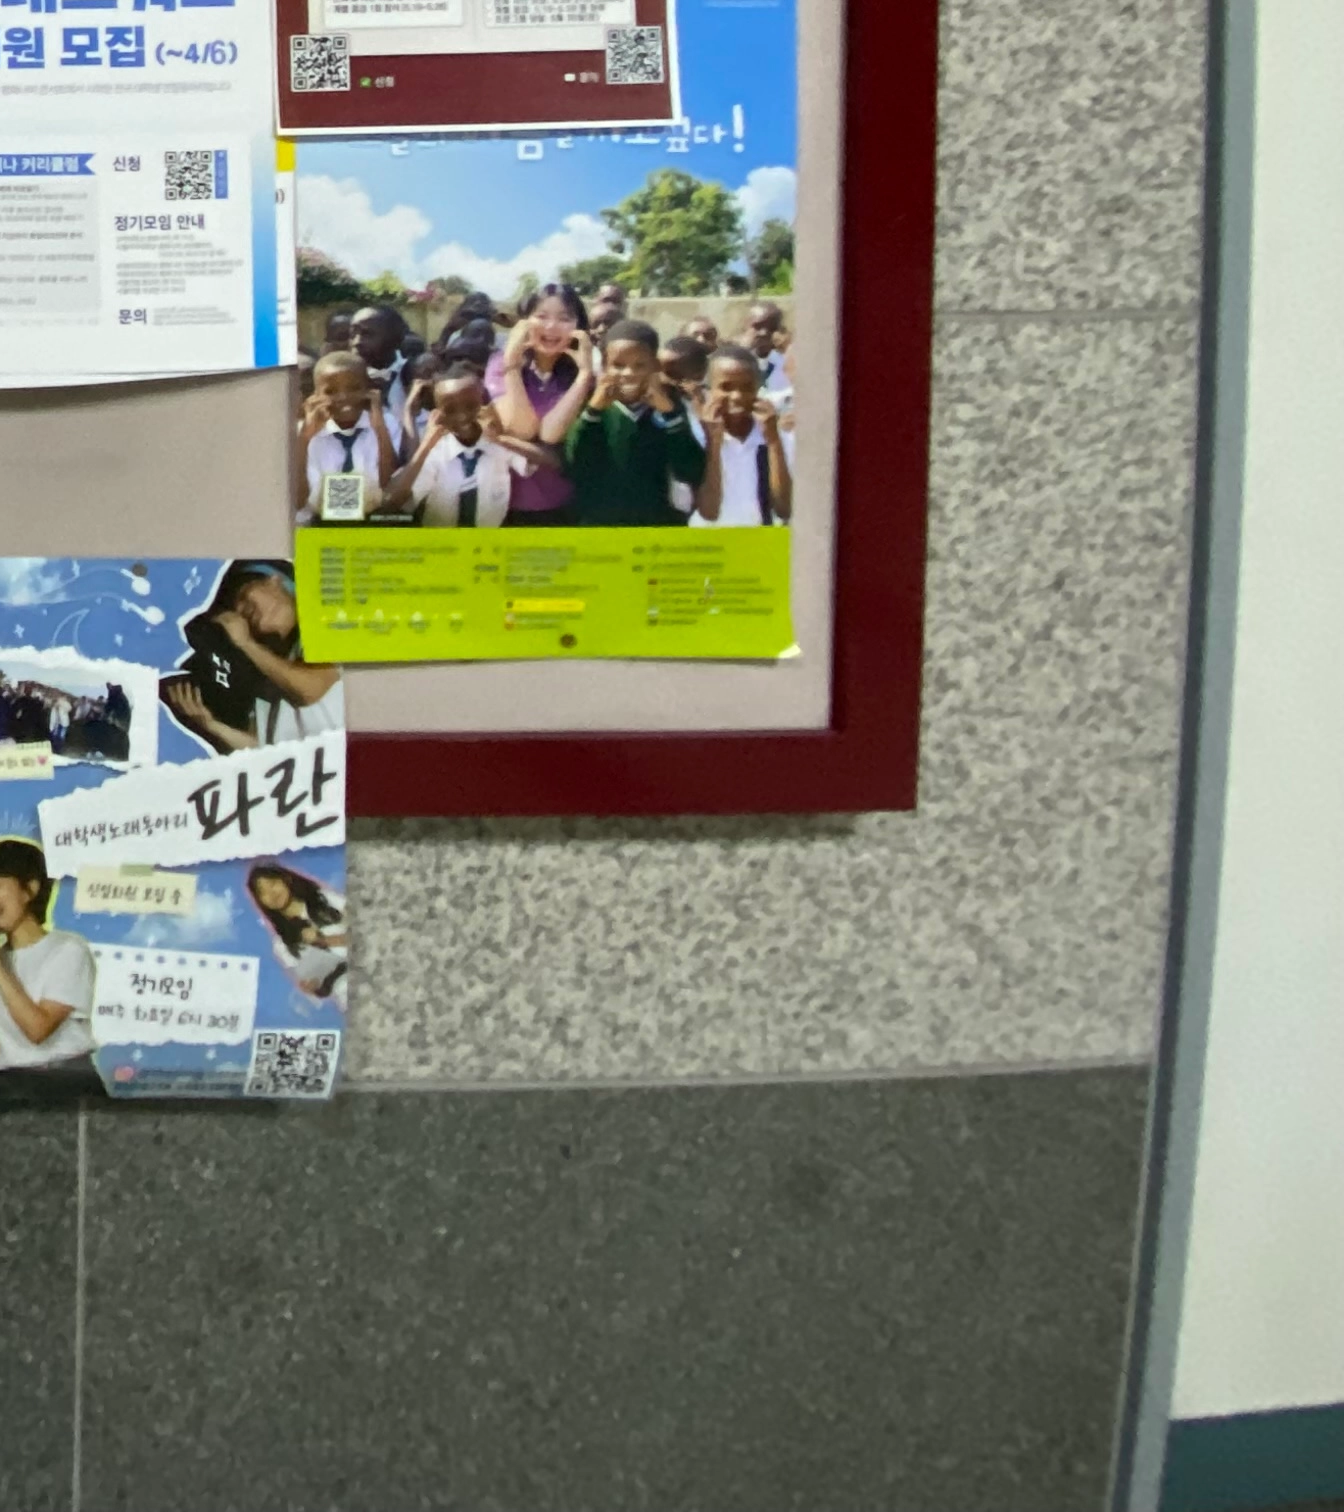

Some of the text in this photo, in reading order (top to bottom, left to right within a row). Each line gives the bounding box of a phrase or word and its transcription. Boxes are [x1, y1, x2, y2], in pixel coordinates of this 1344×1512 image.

[60, 26, 145, 70] 모집
[156, 39, 238, 66] (~4/6)
[21, 157, 80, 173] 커리큘럼
[113, 156, 141, 172] 신청
[114, 214, 205, 231] 정기모임 안내
[118, 308, 147, 325] 문의
[187, 747, 339, 841] 파란
[54, 813, 189, 847] 대학생노래동아리
[130, 974, 193, 1000] 정기모임
